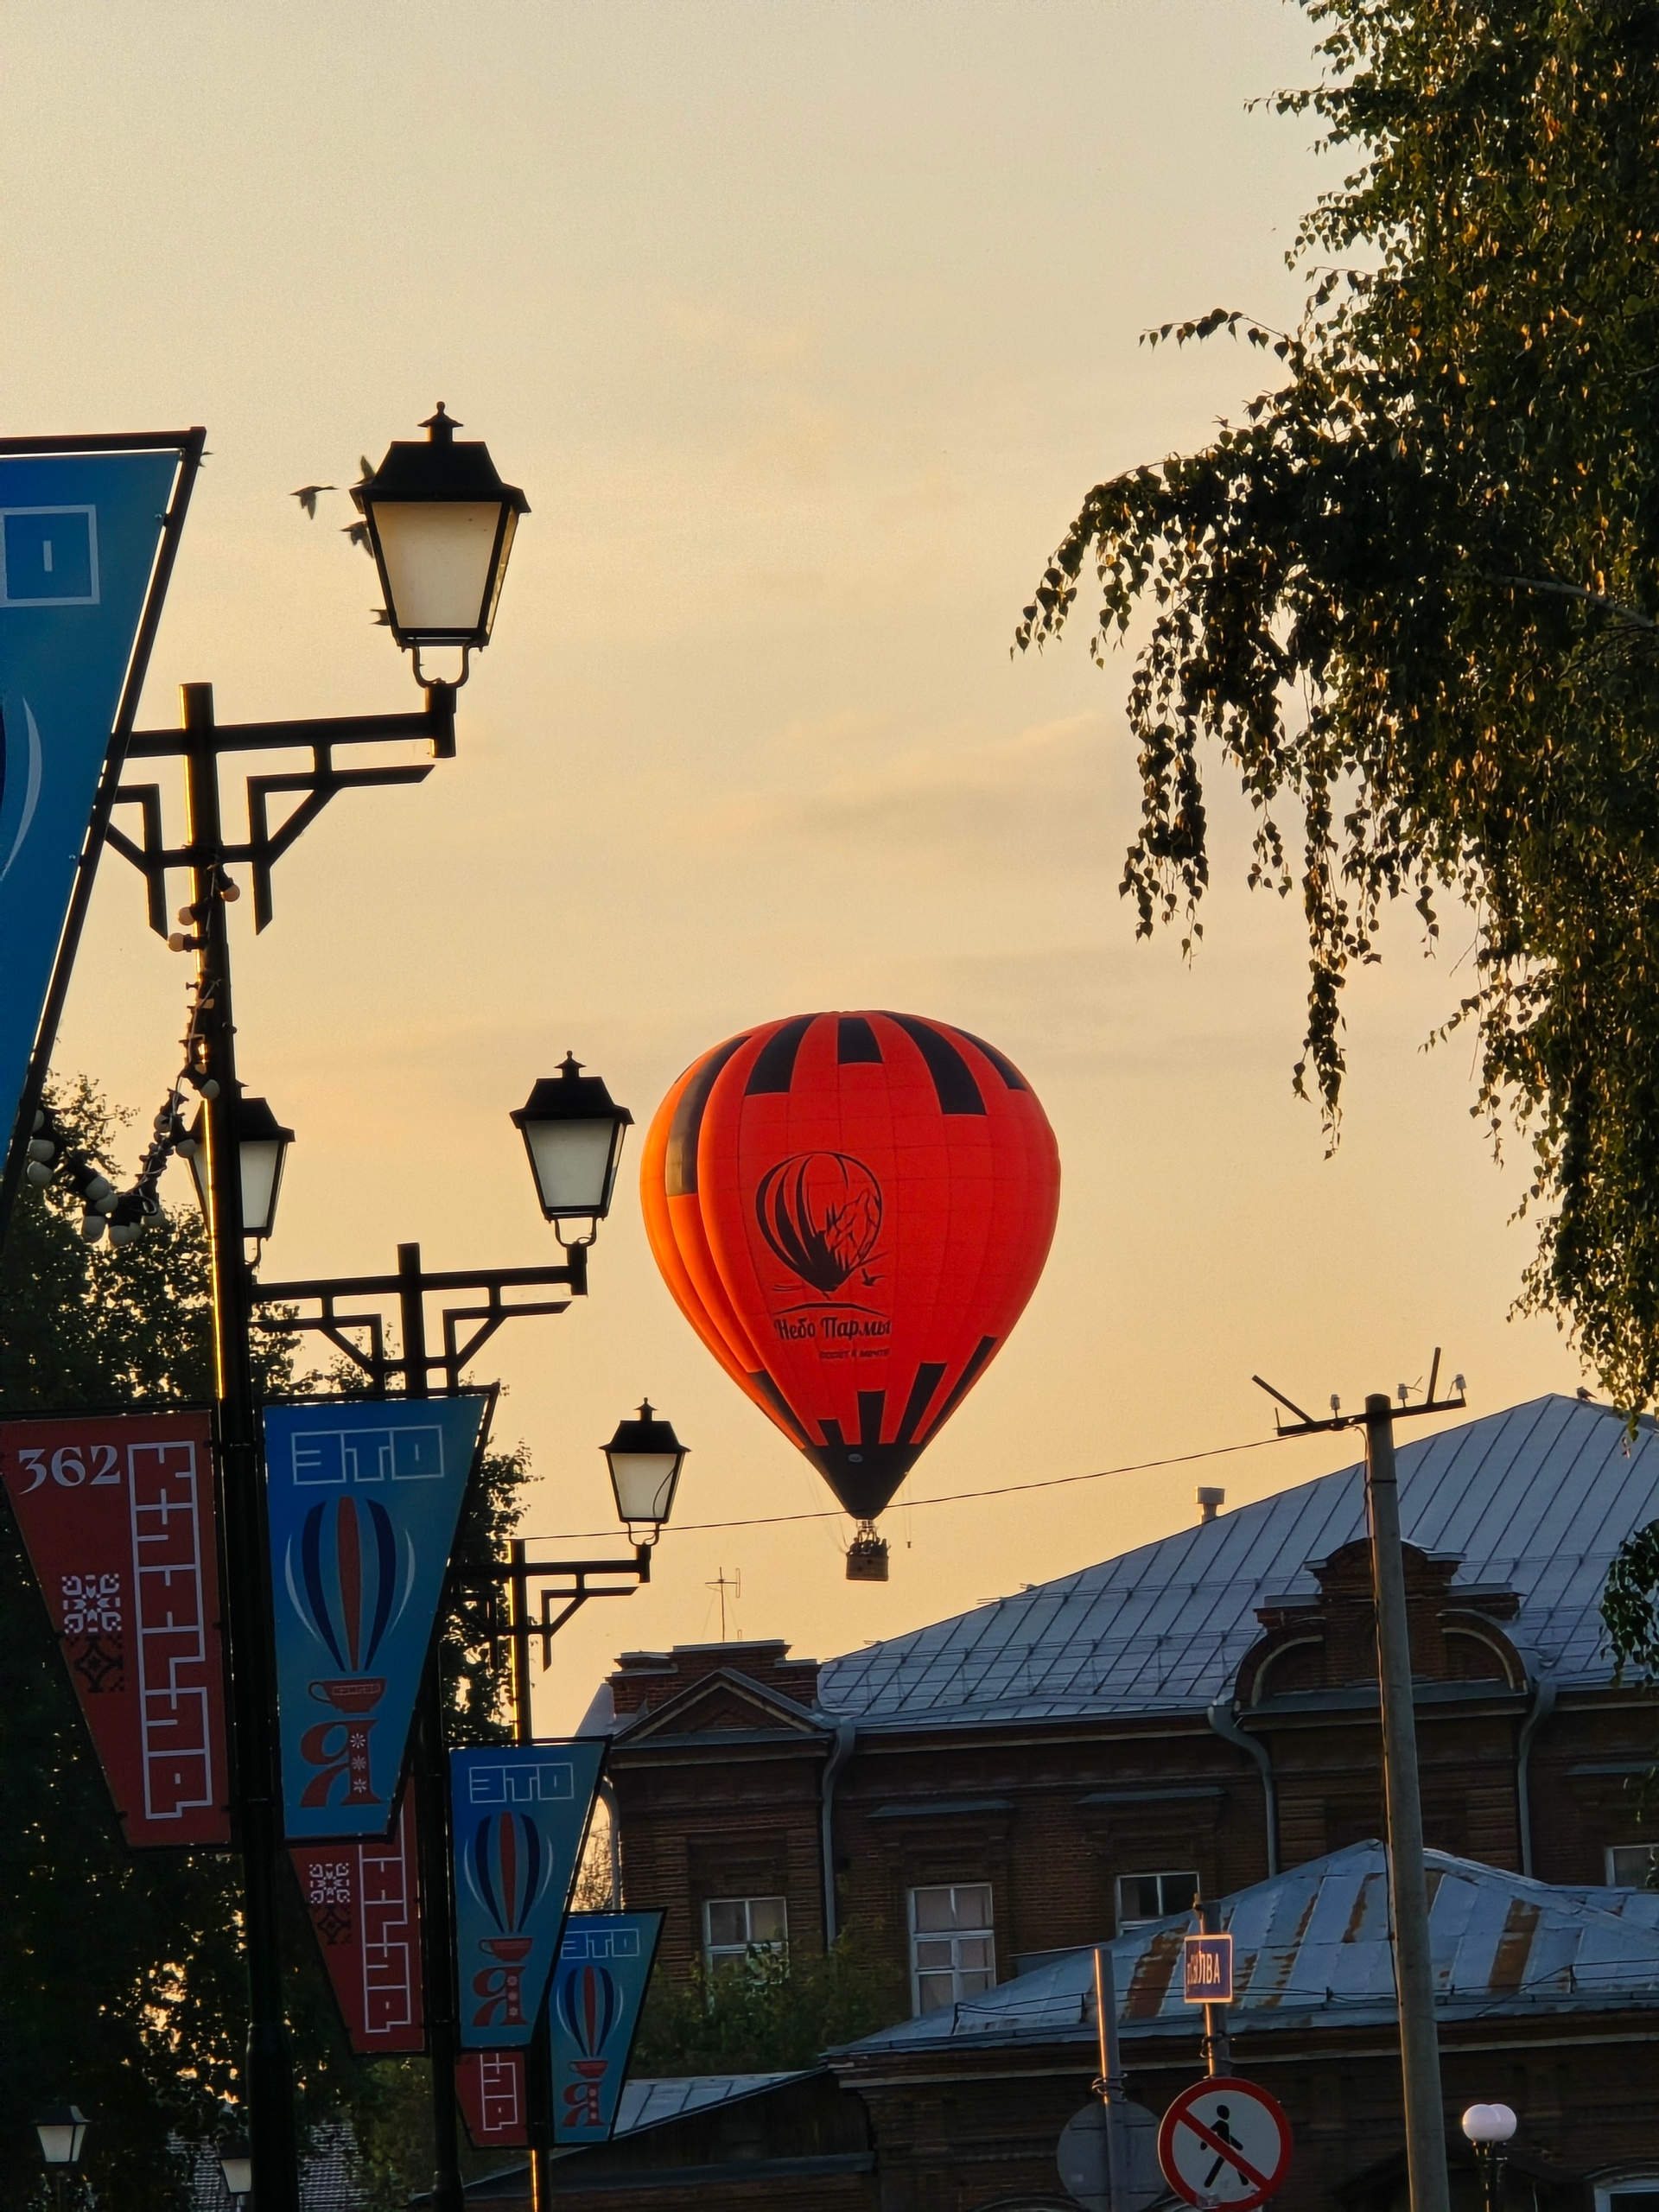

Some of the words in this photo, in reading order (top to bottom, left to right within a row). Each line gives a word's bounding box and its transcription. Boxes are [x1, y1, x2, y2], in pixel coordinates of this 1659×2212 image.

[775, 1318, 816, 1340] Небо
[820, 1317, 892, 1340] Пармы
[18, 1444, 122, 1495] 362
[291, 1425, 444, 1486] ЭТО
[300, 1718, 384, 1808] Я
[468, 1763, 575, 1803] ЭТО
[472, 1965, 529, 2027] Я
[563, 2081, 605, 2127] Я
